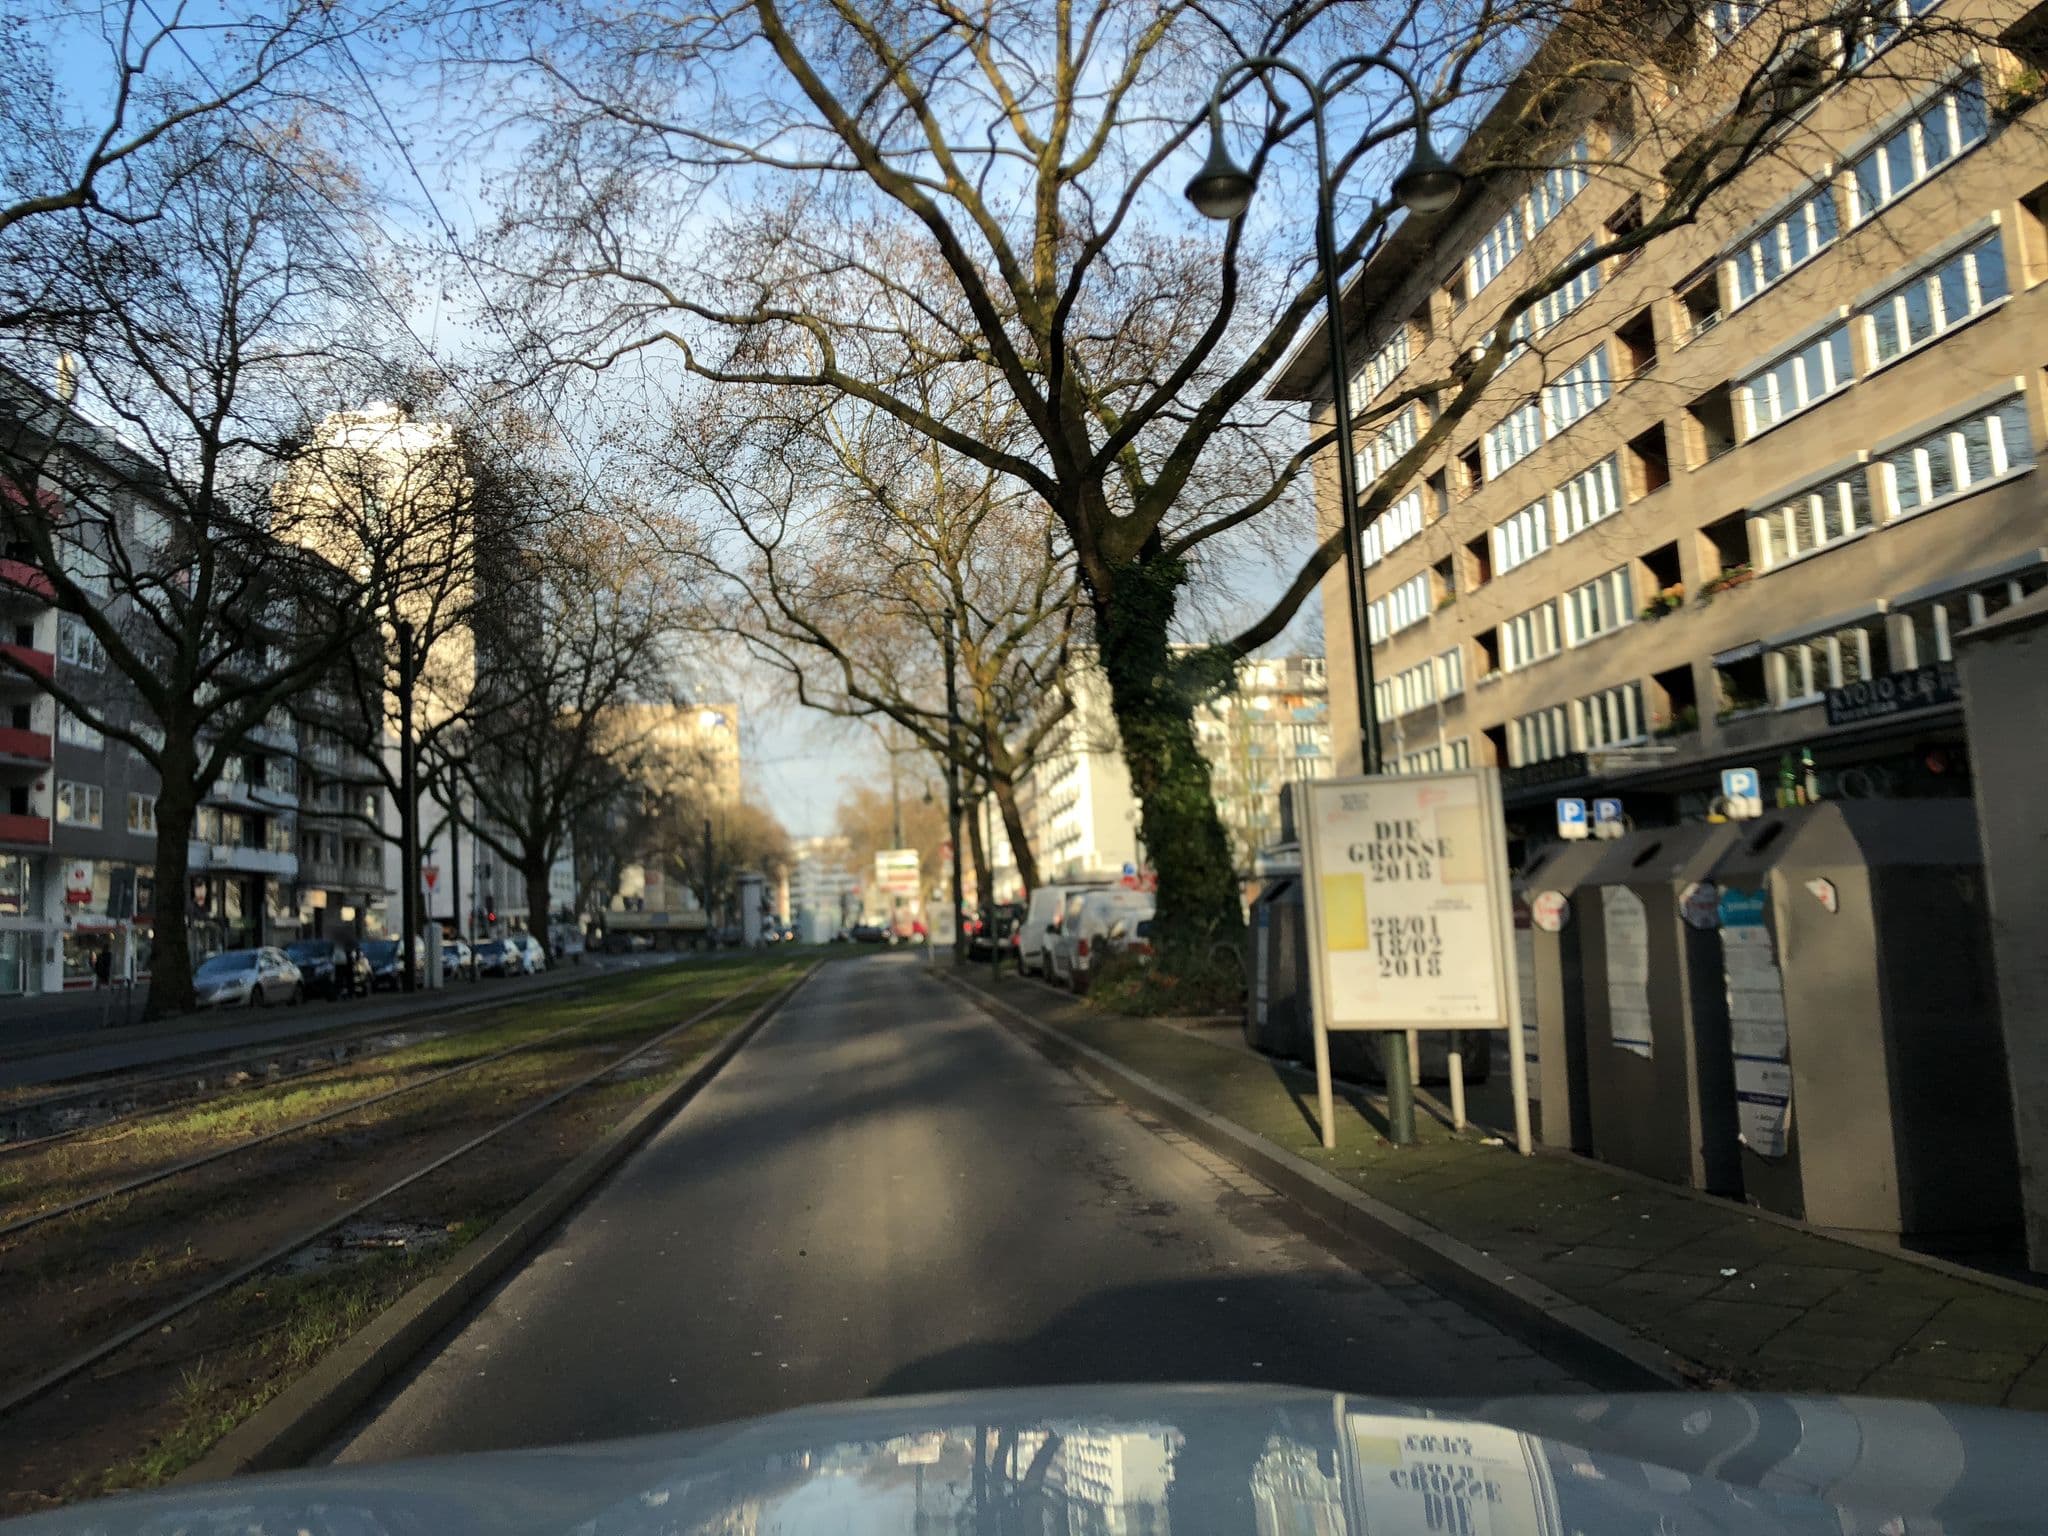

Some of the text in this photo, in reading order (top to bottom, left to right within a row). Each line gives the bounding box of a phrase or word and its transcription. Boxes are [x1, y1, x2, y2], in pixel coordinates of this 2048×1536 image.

[1730, 773, 1750, 794] P
[1564, 801, 1580, 821] P
[1374, 820, 1420, 841] DIE
[1347, 837, 1454, 863] GROSSE
[1371, 860, 1432, 882] 2018
[1379, 956, 1442, 978] 2018
